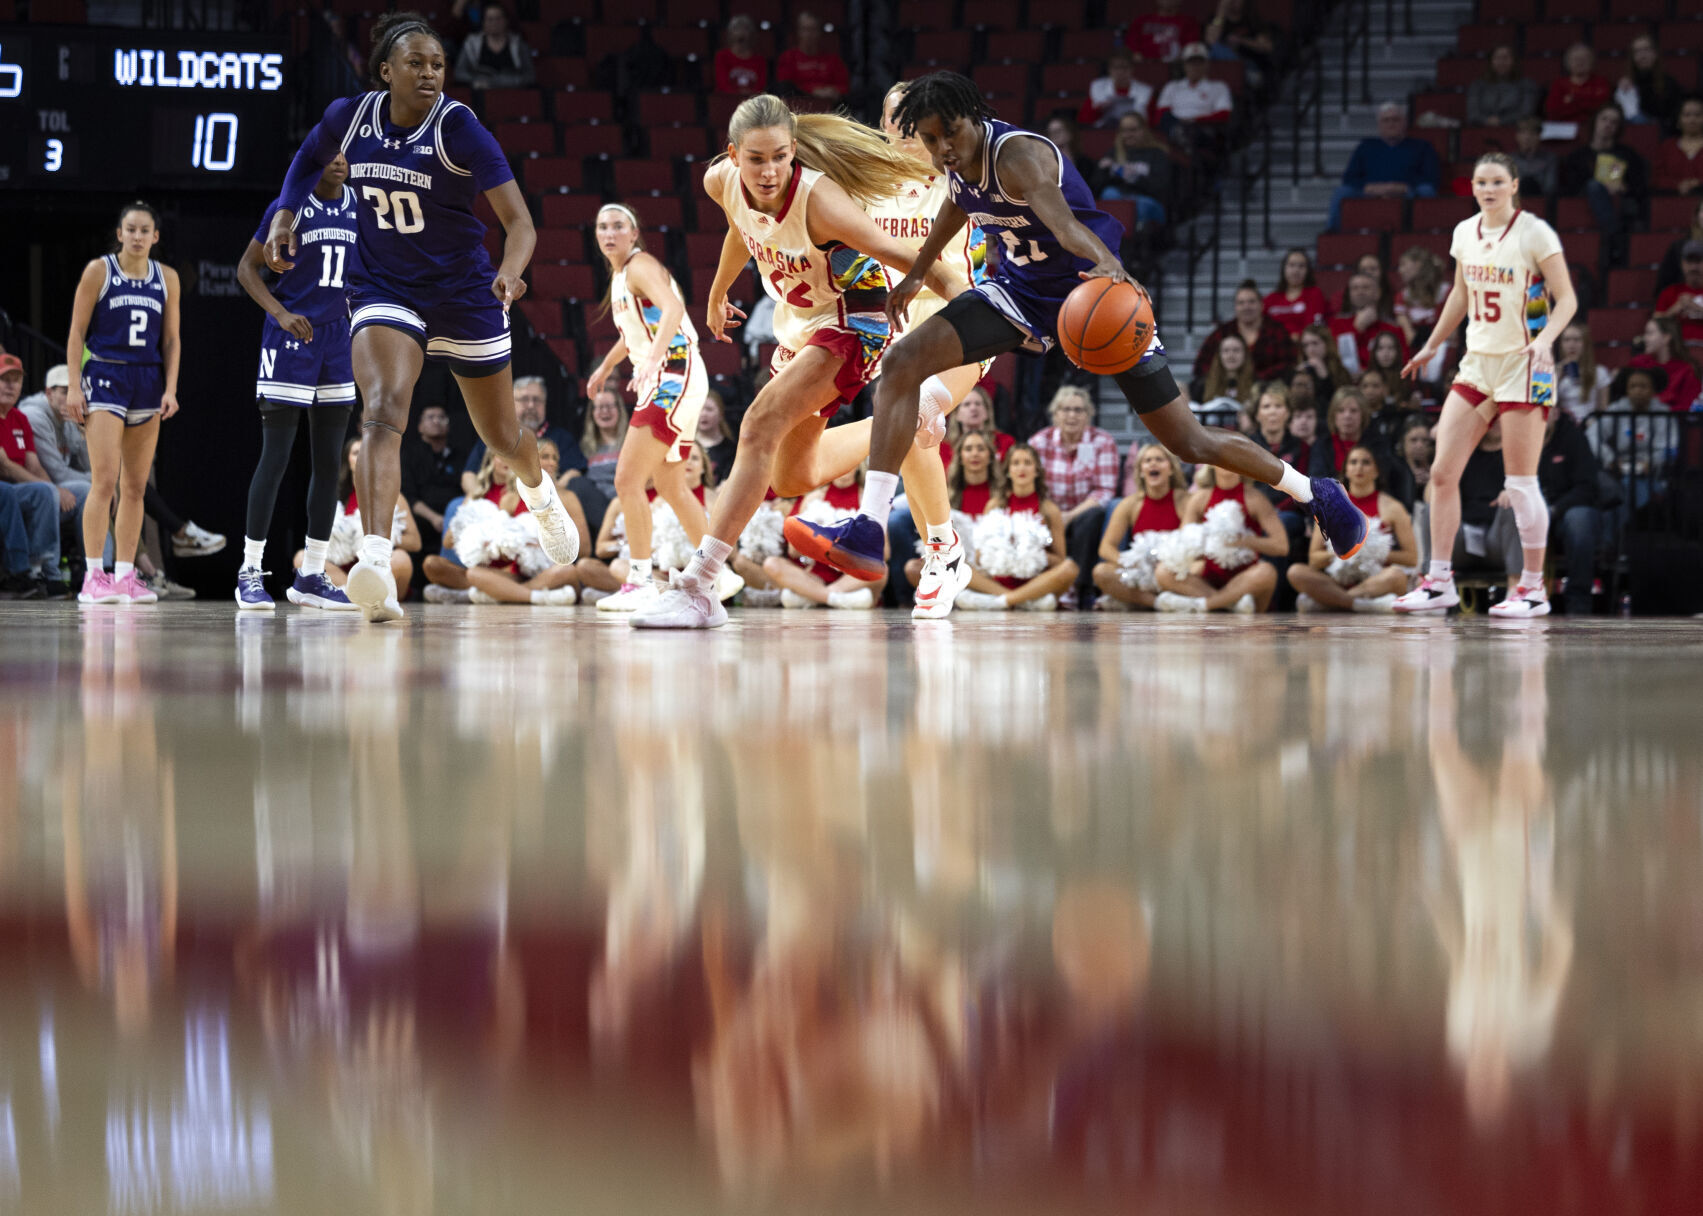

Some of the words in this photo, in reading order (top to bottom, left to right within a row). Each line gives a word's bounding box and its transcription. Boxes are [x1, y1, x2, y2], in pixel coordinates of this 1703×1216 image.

[113, 48, 283, 91] WILDCATS
[38, 110, 71, 133] TOL
[43, 138, 64, 172] 3
[192, 112, 239, 171] 10
[350, 162, 432, 190] NORTHWESTERN
[362, 185, 425, 234] 20
[301, 227, 357, 246] NORTHWESTE
[318, 244, 345, 288] 11
[109, 294, 162, 315] NORTHWESTERN
[1473, 290, 1501, 323] 15
[128, 309, 148, 347] 2
[259, 347, 277, 379] N
